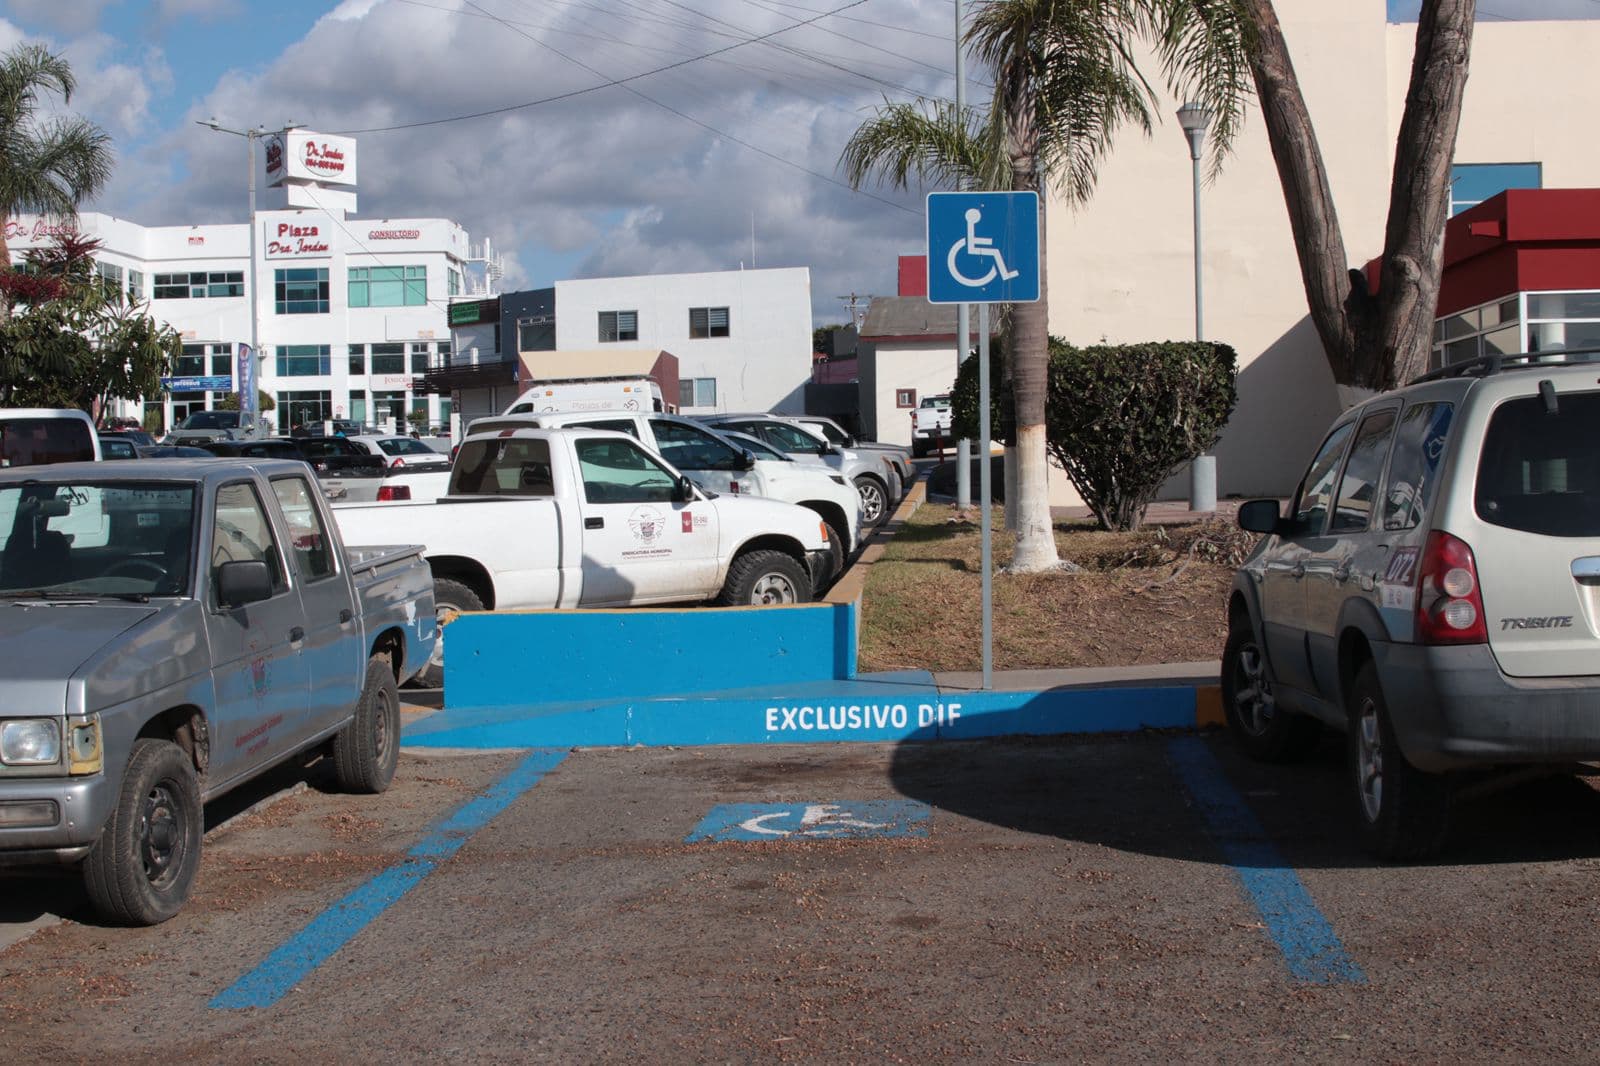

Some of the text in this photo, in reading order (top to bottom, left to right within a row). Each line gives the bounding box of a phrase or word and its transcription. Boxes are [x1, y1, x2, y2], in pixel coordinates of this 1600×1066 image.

[278, 223, 319, 237] Plaza
[368, 230, 420, 240] CONSULTORIO
[268, 241, 293, 254] Dra.
[1386, 552, 1416, 582] 072
[1500, 615, 1574, 631] TRIBUTE
[766, 703, 962, 731] EXCLUSIVO DIF
